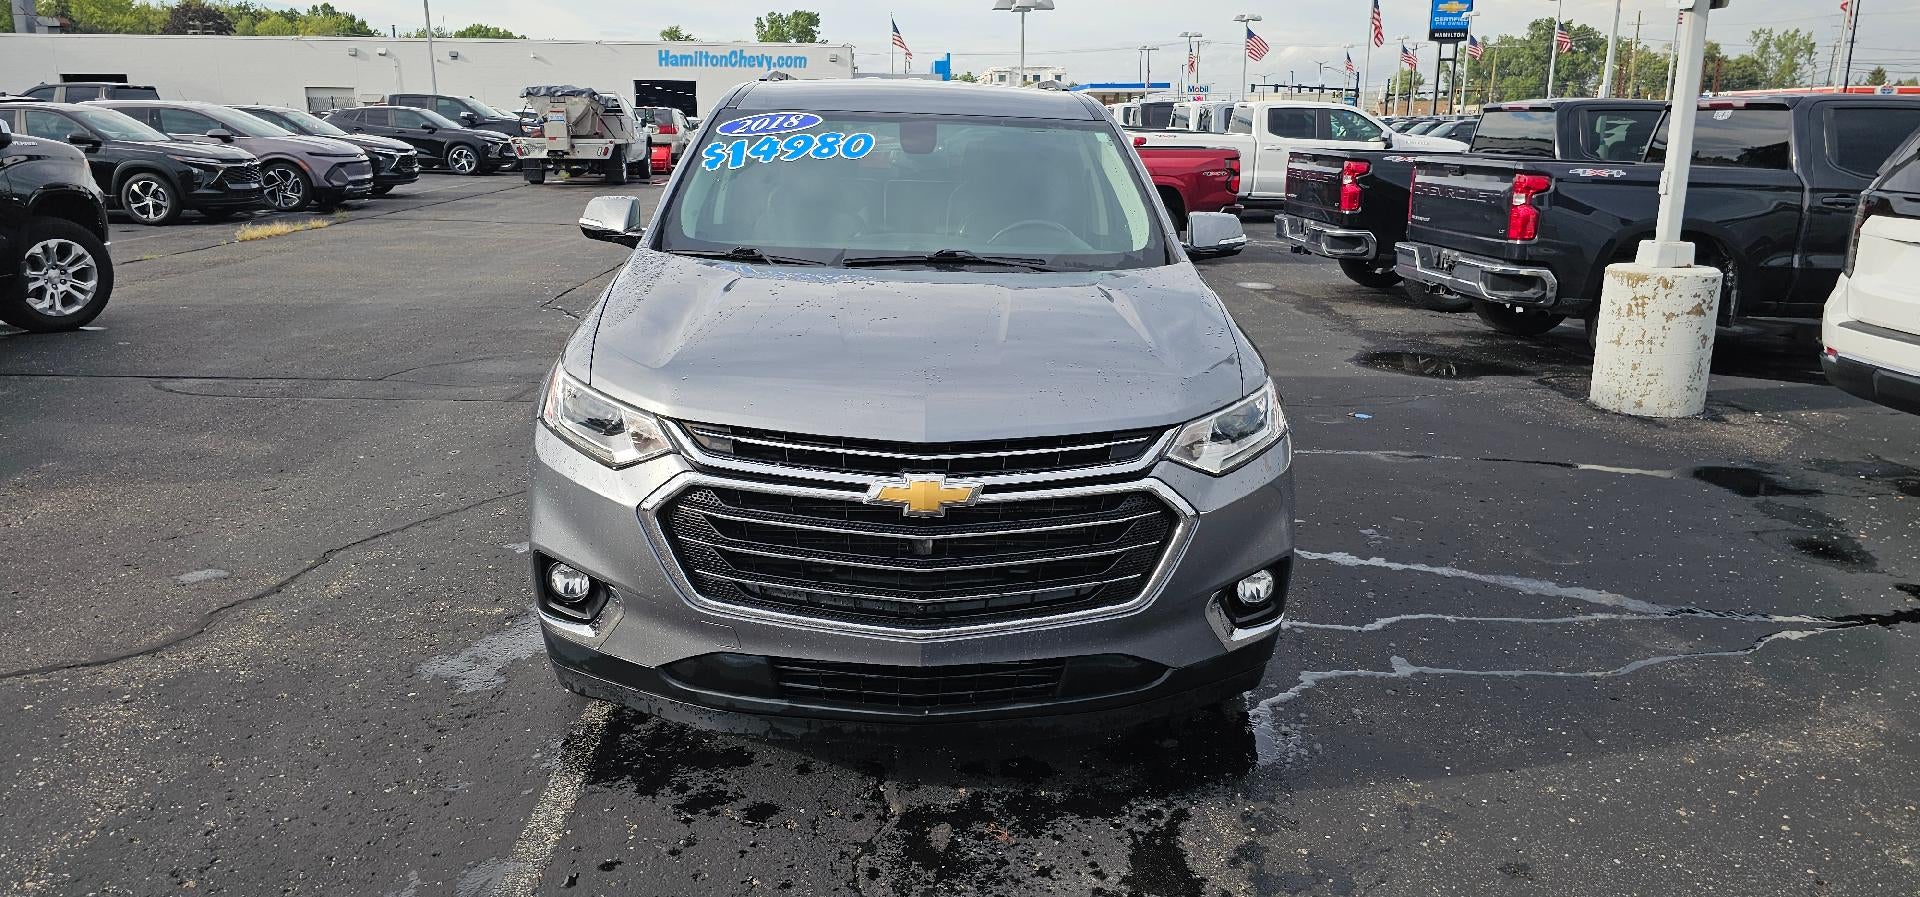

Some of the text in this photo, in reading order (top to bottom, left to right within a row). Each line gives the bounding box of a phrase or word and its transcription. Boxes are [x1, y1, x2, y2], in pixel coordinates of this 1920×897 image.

[658, 49, 807, 71] HamiltonChevy.com
[1187, 85, 1209, 93] Mobil
[736, 114, 804, 134] 2018
[702, 132, 876, 171] $14980
